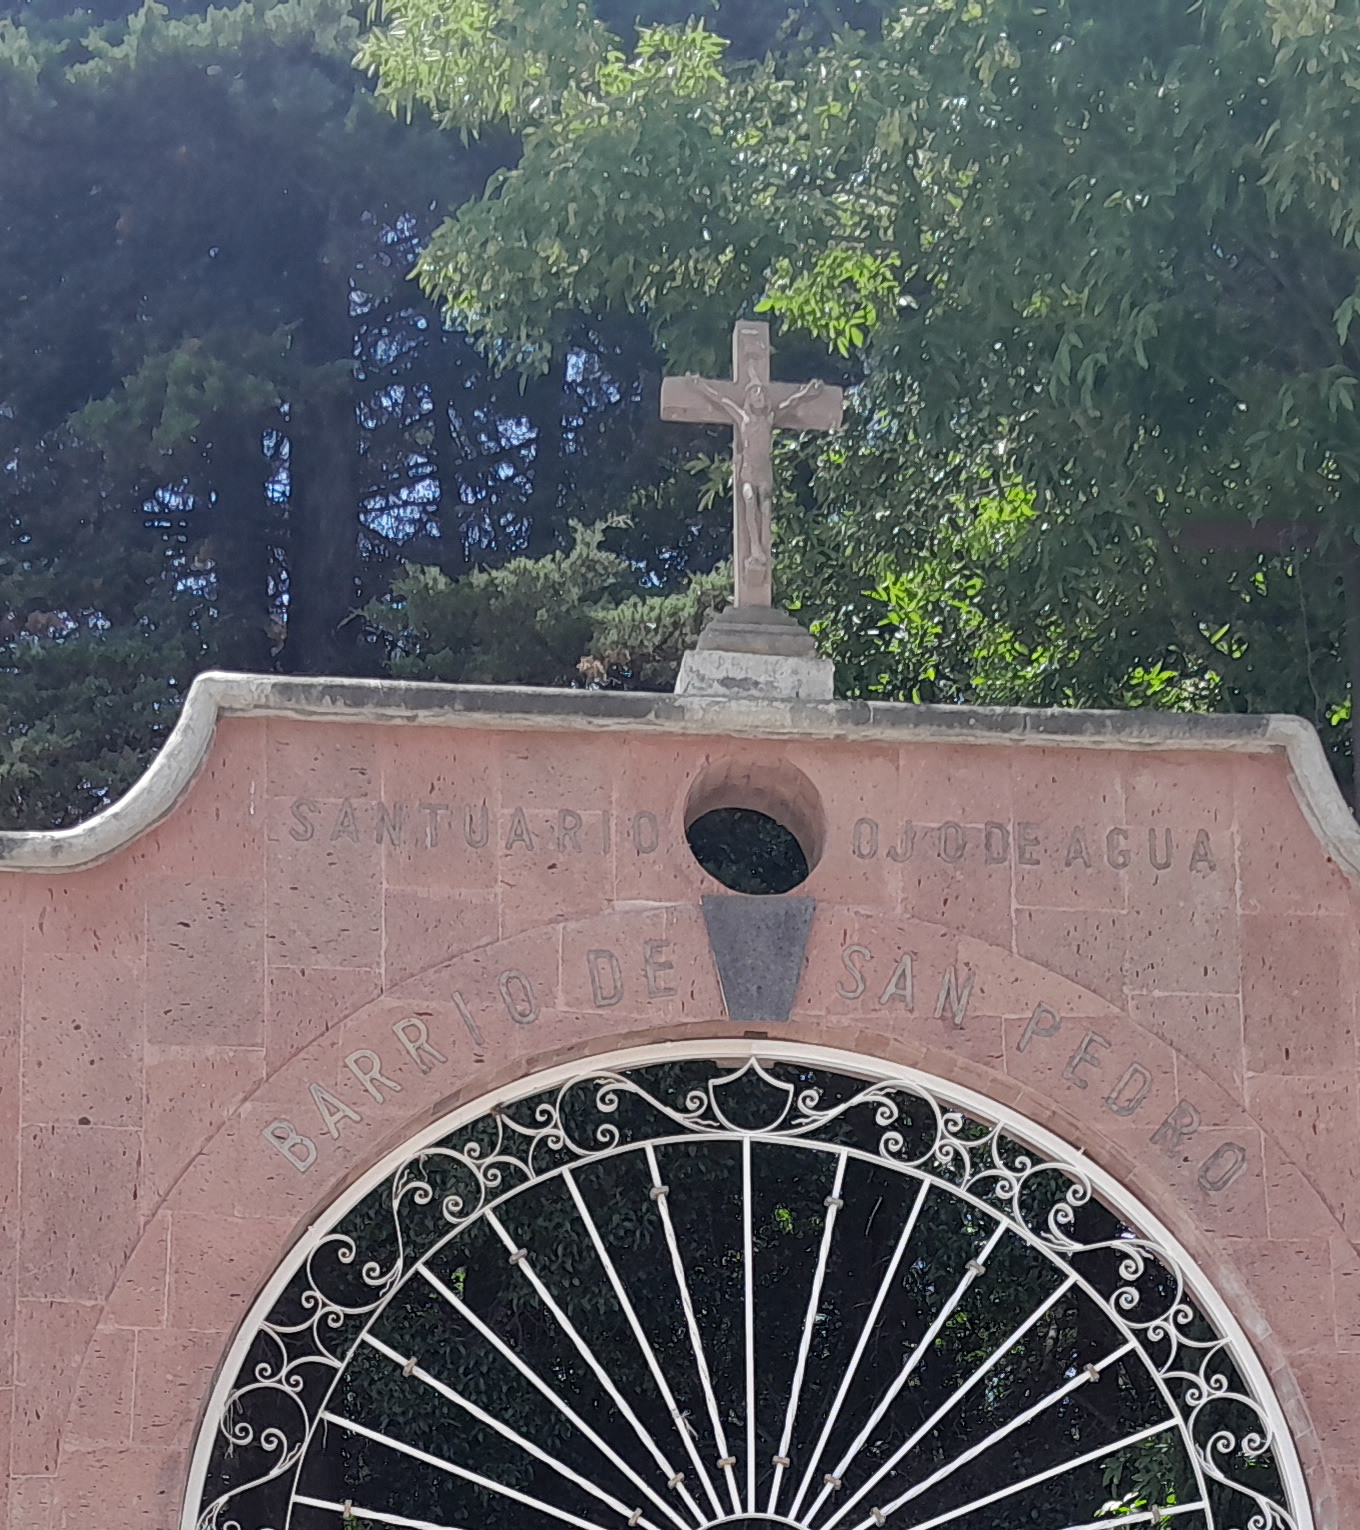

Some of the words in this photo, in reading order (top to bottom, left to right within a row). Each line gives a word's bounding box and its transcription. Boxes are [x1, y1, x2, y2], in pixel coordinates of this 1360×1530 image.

[288, 799, 660, 855] SANTUARIO
[262, 968, 540, 1174] BARRIO
[587, 938, 677, 1008] DE
[837, 944, 977, 1028] SAN
[1016, 1001, 1247, 1191] PEDRO
